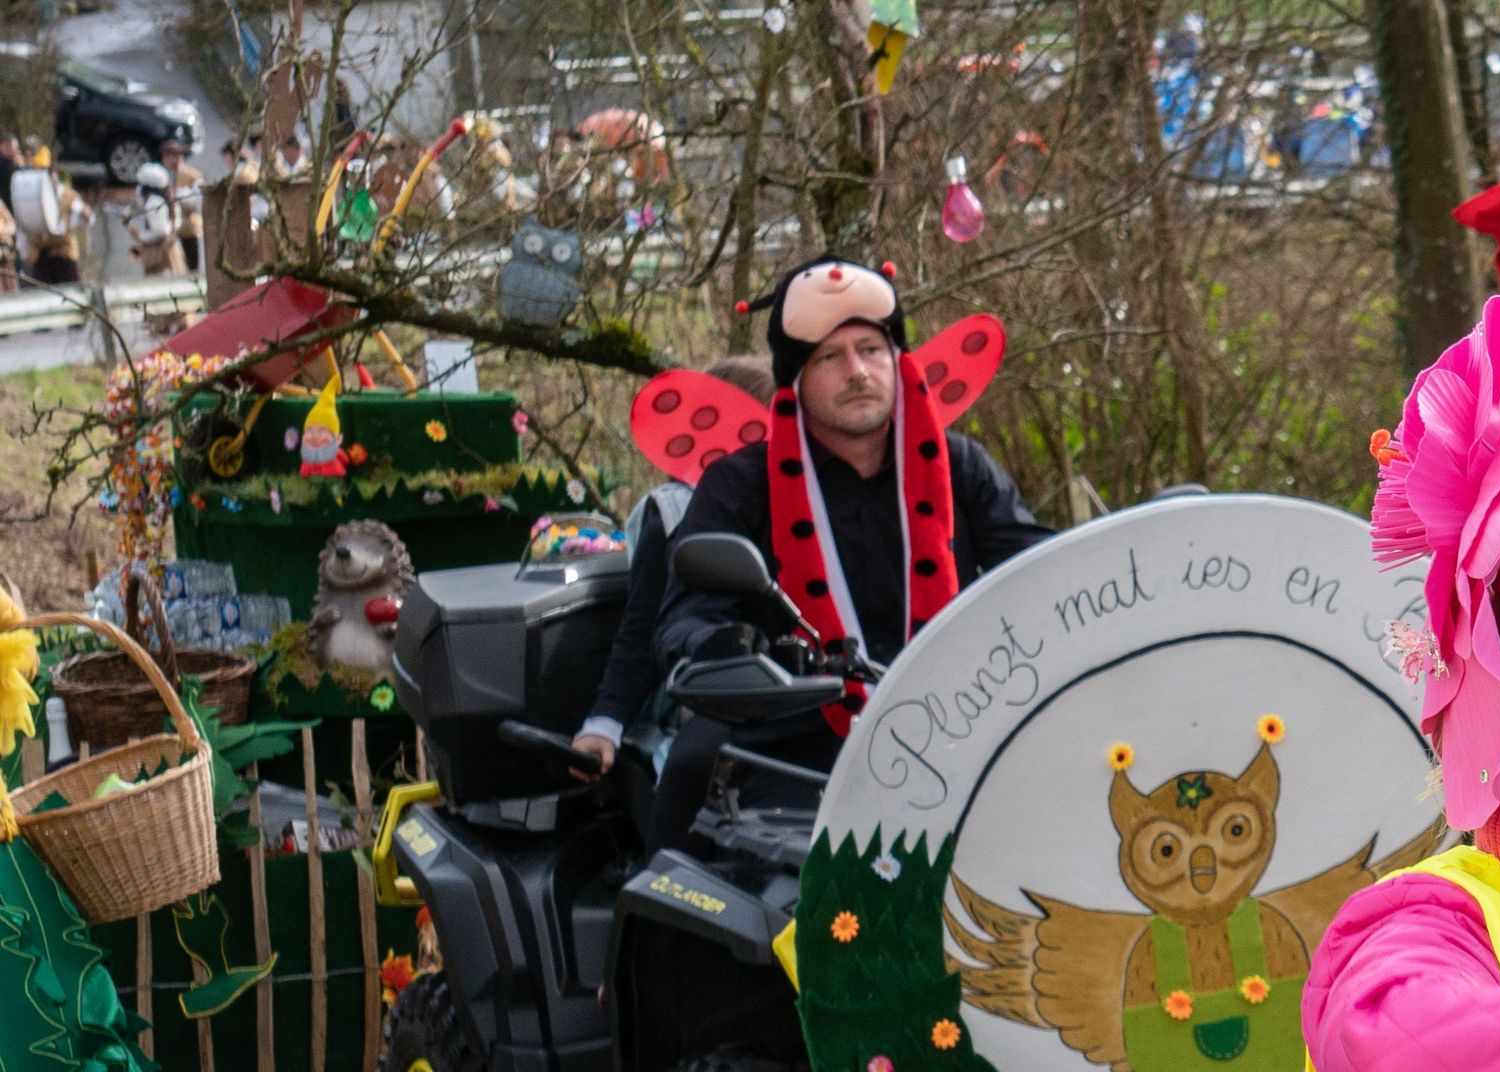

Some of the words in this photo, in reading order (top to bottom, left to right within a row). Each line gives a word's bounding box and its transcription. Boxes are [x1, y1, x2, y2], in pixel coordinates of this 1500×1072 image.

[1054, 547, 1156, 634] mat
[1182, 541, 1251, 592] ies
[1286, 565, 1340, 614] en
